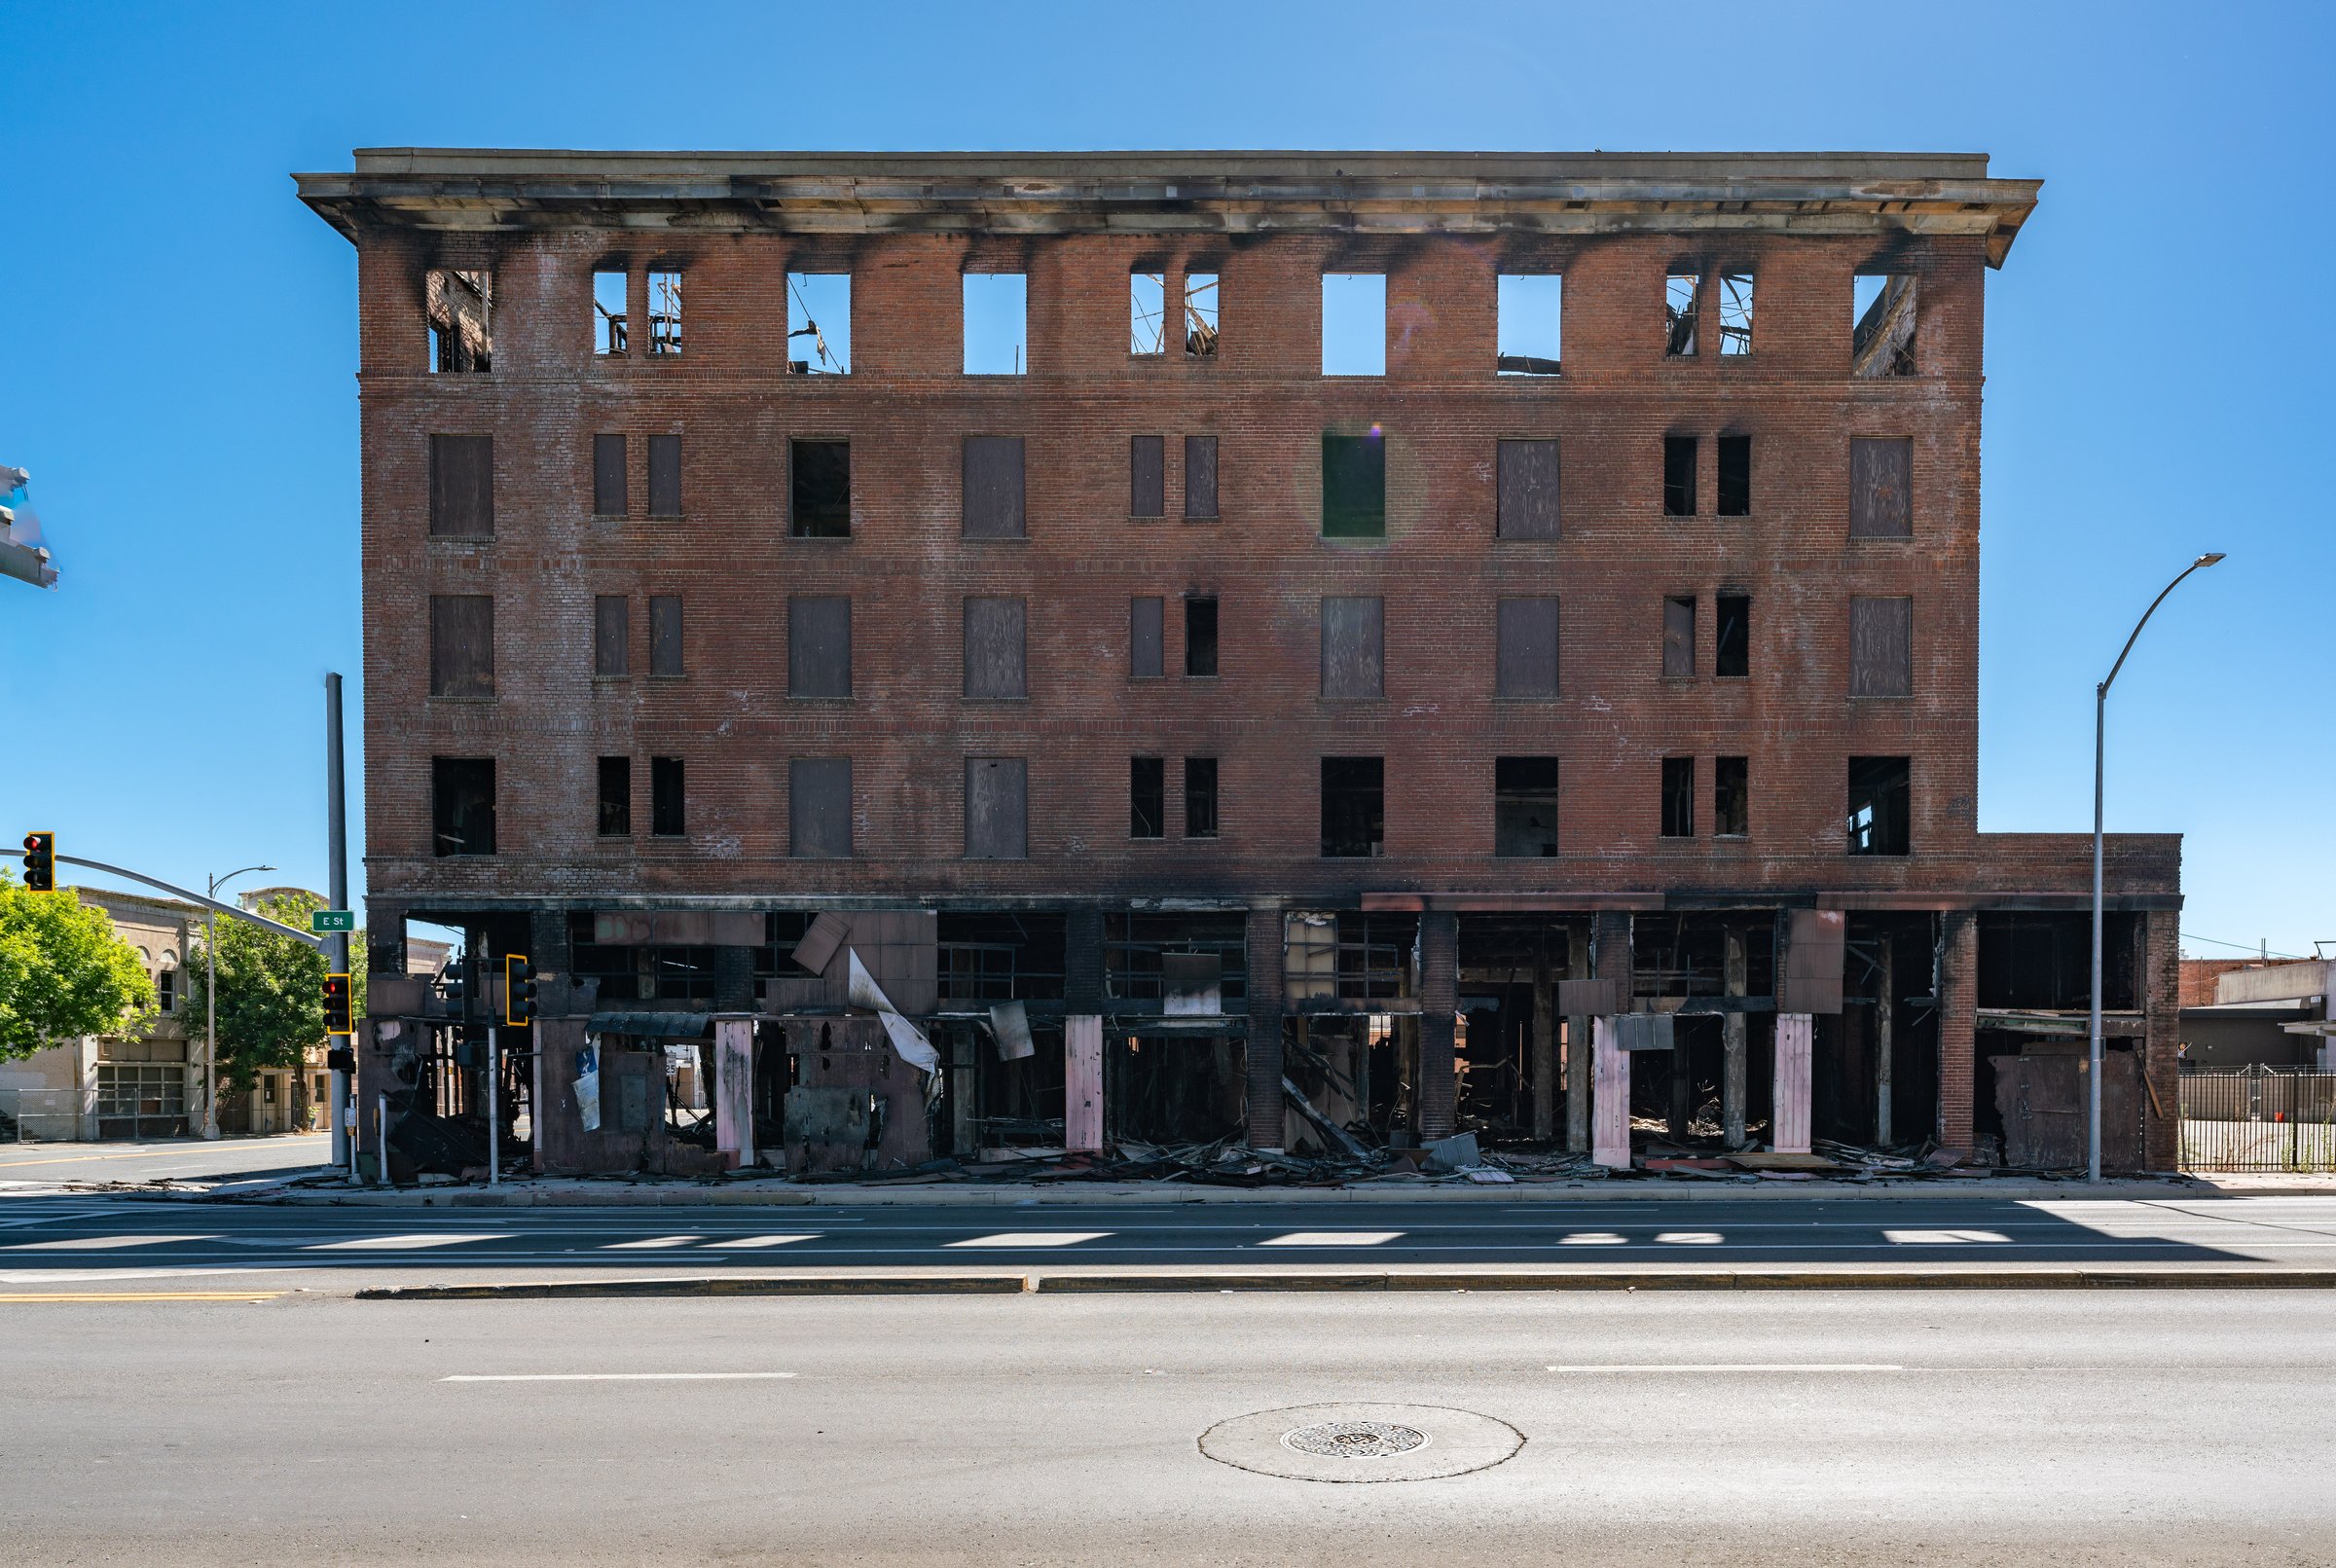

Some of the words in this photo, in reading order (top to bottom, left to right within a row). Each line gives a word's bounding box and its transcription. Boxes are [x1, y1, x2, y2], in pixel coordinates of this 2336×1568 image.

[323, 917, 330, 926] E
[333, 917, 344, 926] St
[666, 1065, 675, 1074] 25
